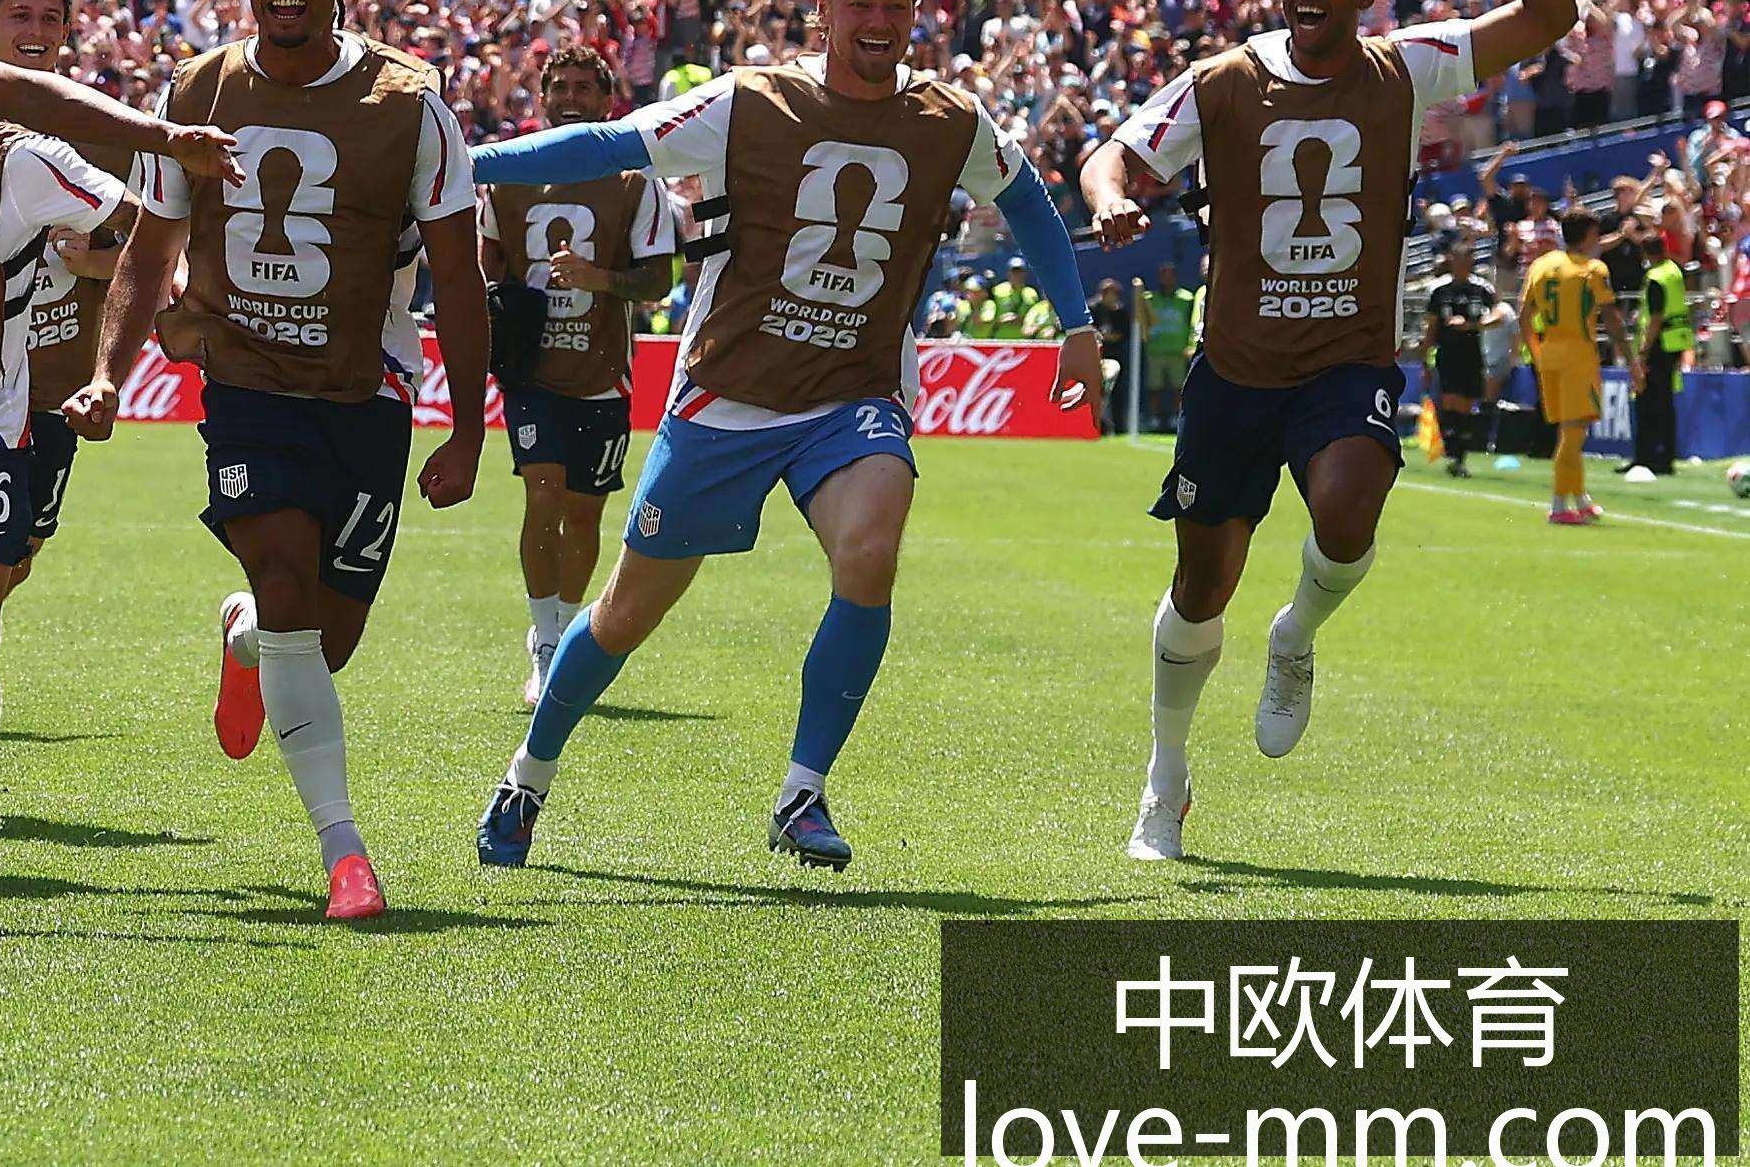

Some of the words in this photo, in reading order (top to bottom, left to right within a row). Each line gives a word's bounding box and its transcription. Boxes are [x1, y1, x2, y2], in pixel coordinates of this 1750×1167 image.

[1290, 244, 1336, 261] FIFA
[251, 261, 300, 283] FIFA
[809, 268, 856, 293] FIFA
[1260, 278, 1321, 294] WORLD
[1325, 278, 1359, 294] CUP
[50, 301, 79, 320] CUP
[227, 294, 288, 318] WORLD
[290, 304, 329, 320] CUP
[769, 297, 835, 324] WORLD
[836, 311, 868, 328] CUP
[1258, 295, 1359, 319] 2026
[1544, 278, 1560, 327] 5
[27, 318, 79, 350] 026
[566, 321, 591, 333] CUP
[758, 314, 858, 350] 2026
[540, 333, 590, 352] 026
[1374, 388, 1392, 418] 6
[597, 434, 626, 476] 10
[221, 465, 246, 480] USA
[334, 491, 394, 560] 12
